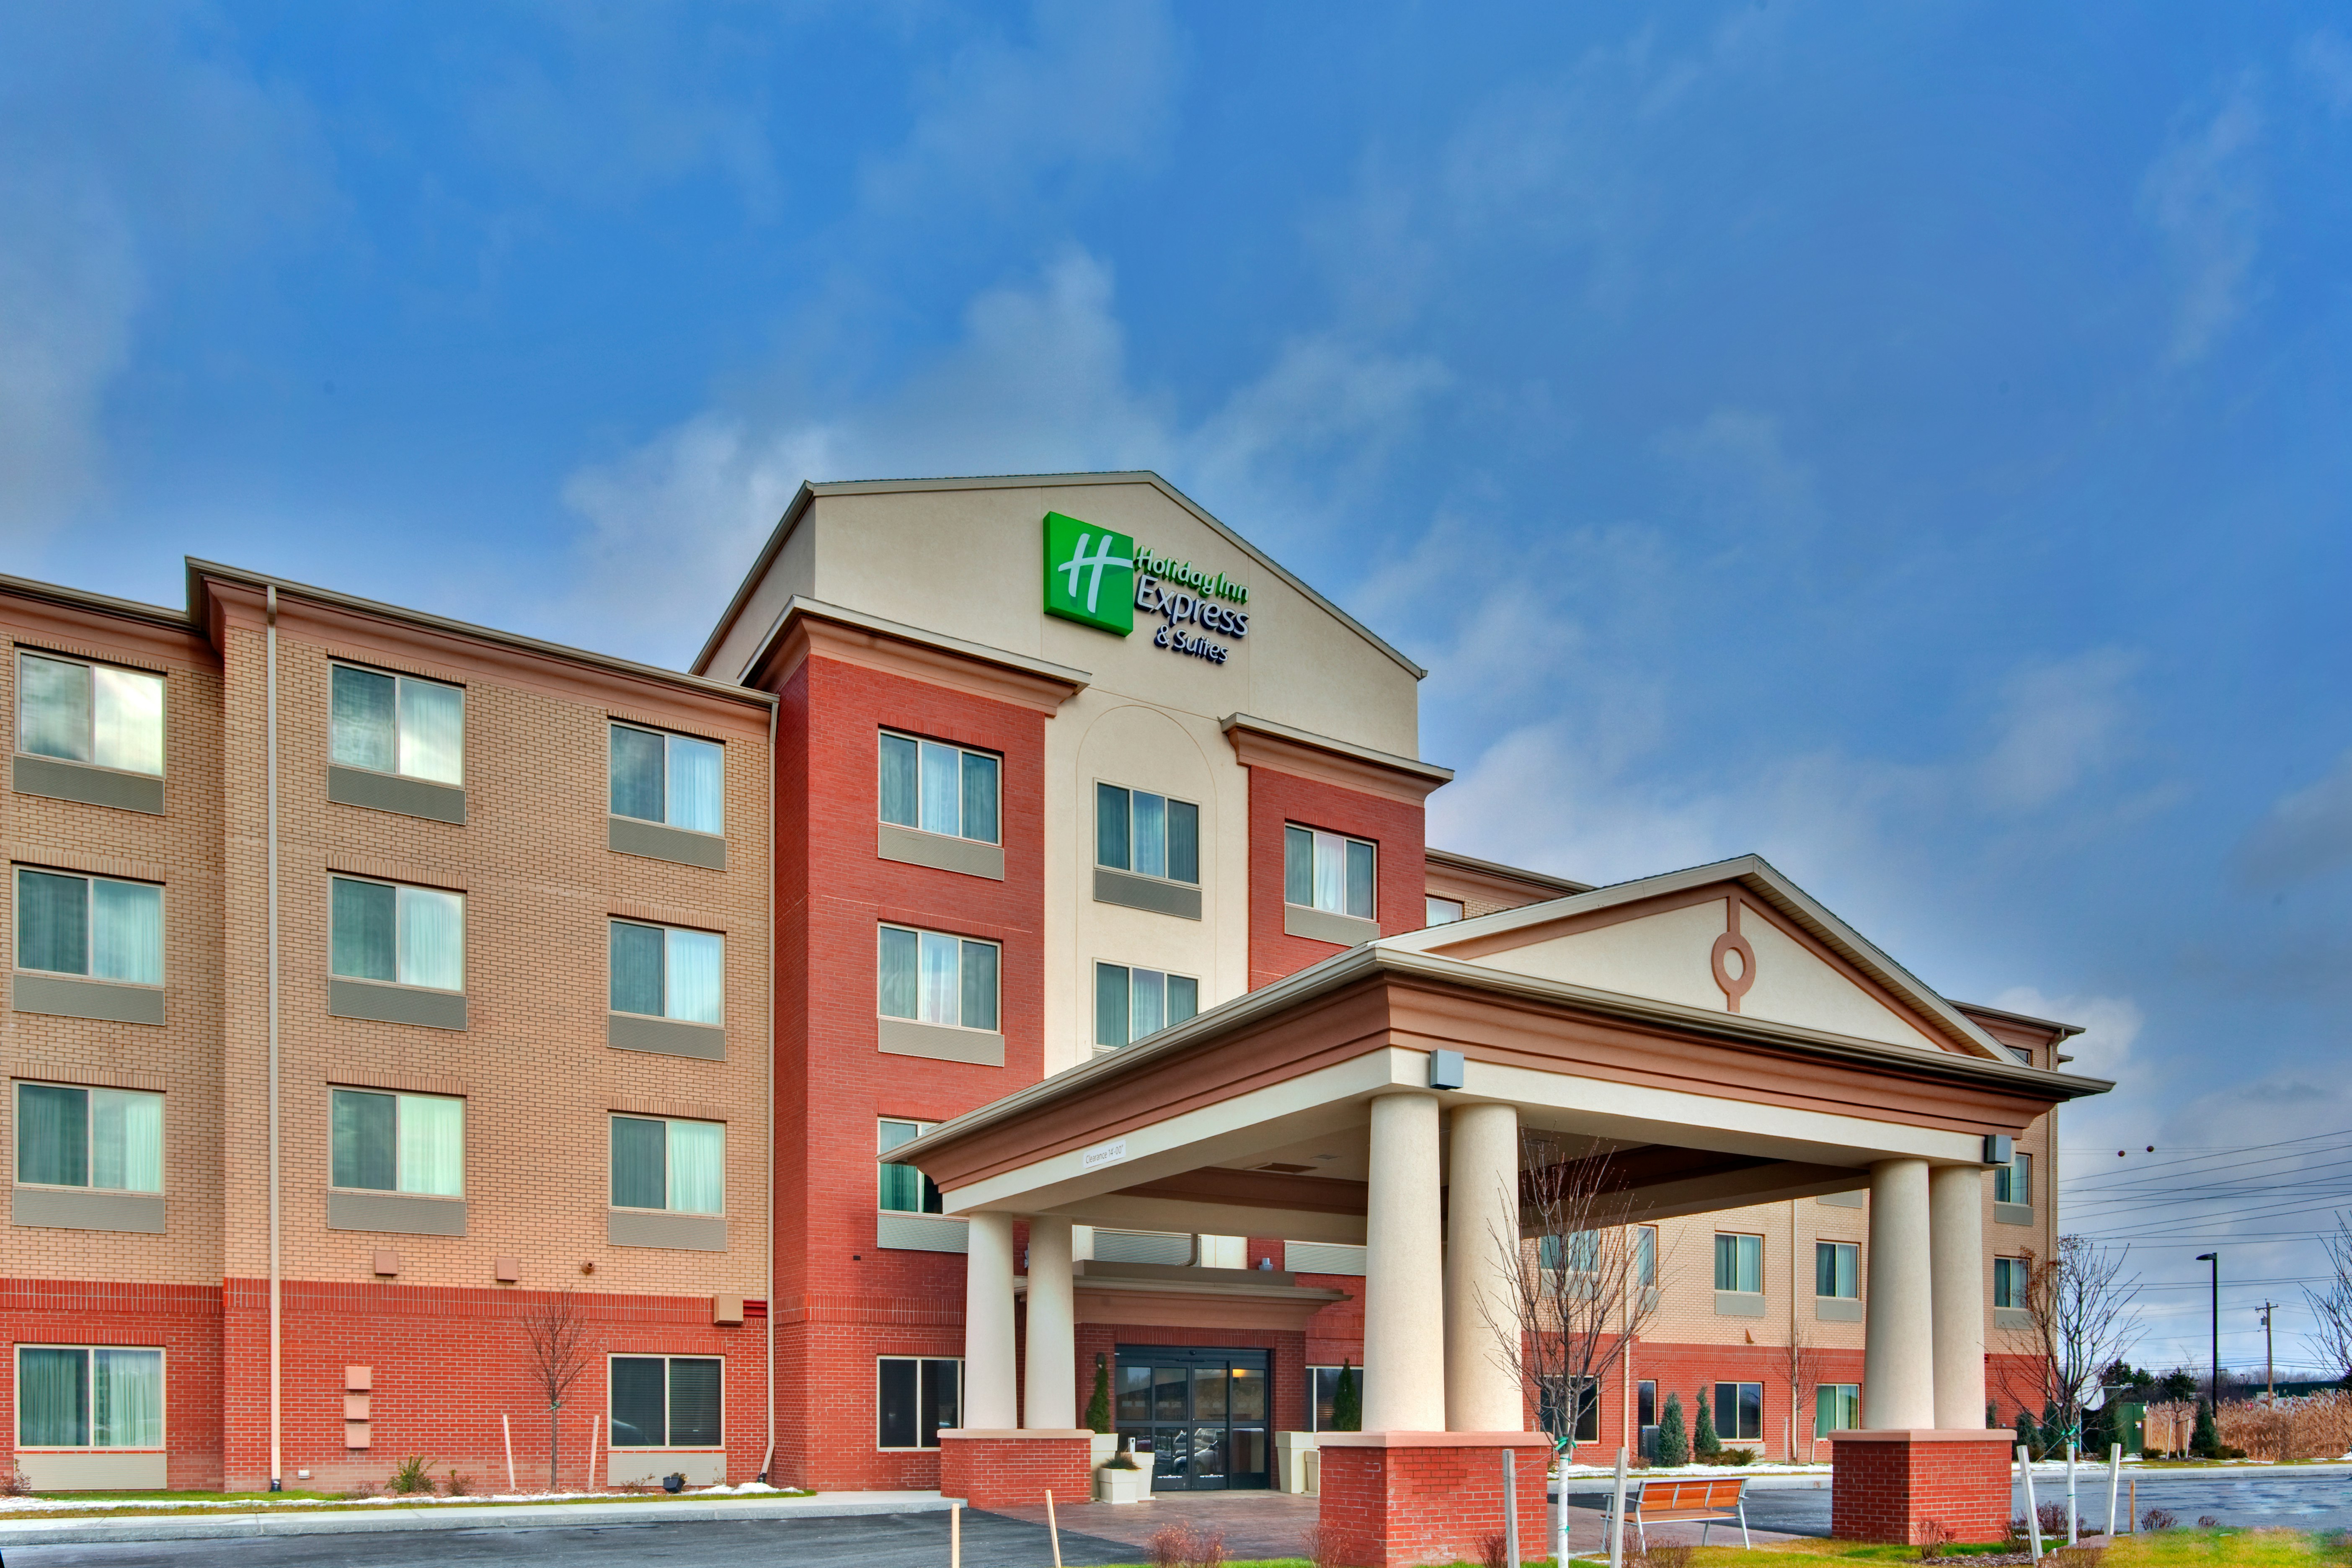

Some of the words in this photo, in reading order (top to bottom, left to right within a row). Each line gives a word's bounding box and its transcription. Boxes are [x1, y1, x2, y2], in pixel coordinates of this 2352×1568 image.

[1134, 545, 1216, 597] Holiday
[1216, 571, 1249, 604] Inn
[1135, 574, 1250, 638] Express
[1155, 624, 1170, 648] &
[1172, 629, 1229, 663] Suites
[1086, 1152, 1108, 1164] Clearance
